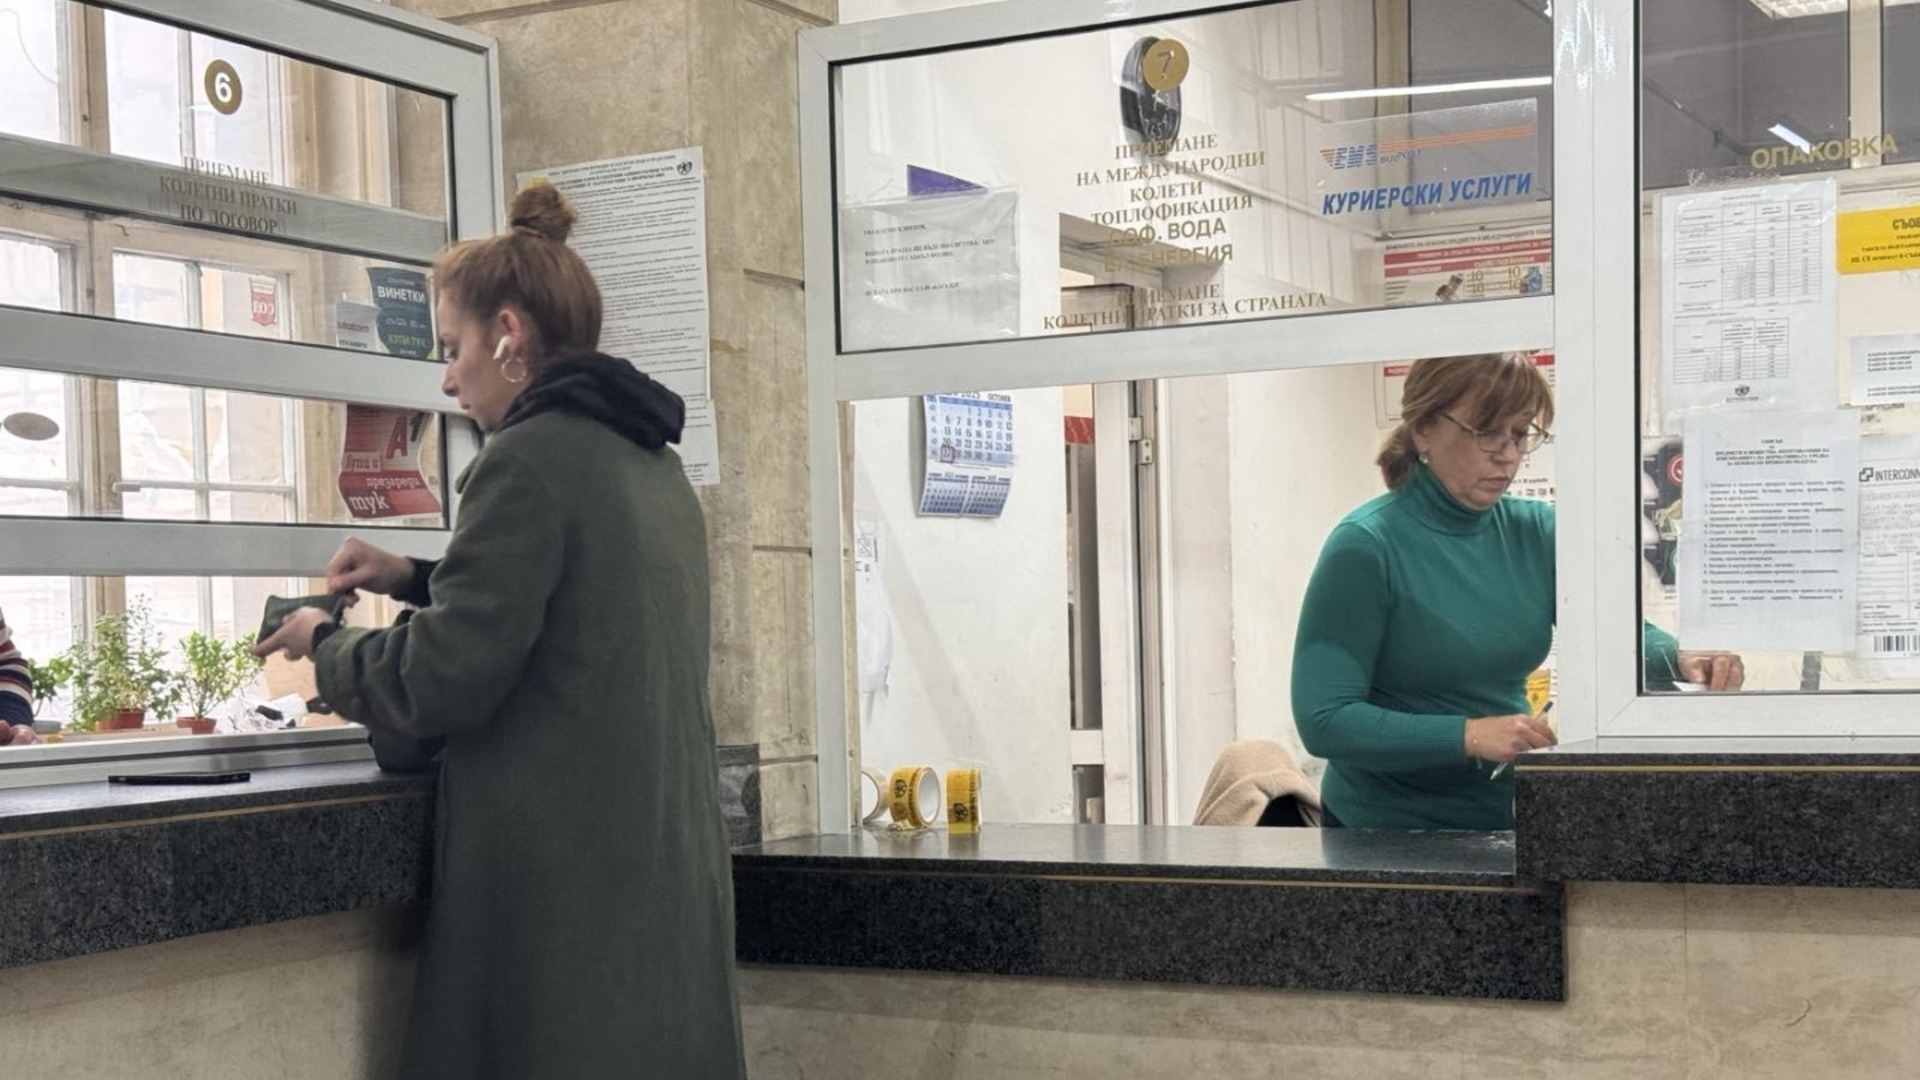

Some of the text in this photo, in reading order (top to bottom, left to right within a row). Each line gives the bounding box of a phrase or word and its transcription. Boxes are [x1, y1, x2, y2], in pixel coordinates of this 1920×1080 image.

[214, 72, 233, 103] 6
[1115, 134, 1219, 160] ПРИЕМАНЕ
[1751, 133, 1898, 169] ОПАКОВКА
[183, 156, 270, 186] ПРИЕМАНЕ
[1077, 151, 1267, 187] НА МЕЖДУНАРОДНИ
[160, 175, 298, 216] КОЛЕТНИ ПРАТКИ
[1129, 181, 1203, 202] КОЛЕТИ
[1322, 172, 1532, 215] КУРИЕРСКИ УСЛУГИ
[181, 204, 278, 234] ПО ДОГОВОР
[1091, 194, 1254, 226] ТОПЛОФИКАЦИЯ
[1167, 217, 1227, 240] ВОДА
[377, 286, 426, 304] ВИНЕТКИ
[1208, 302, 1229, 317] ЗА
[1234, 292, 1328, 315] СТРАНАТА
[386, 408, 425, 460] A1
[349, 491, 390, 515] тук
